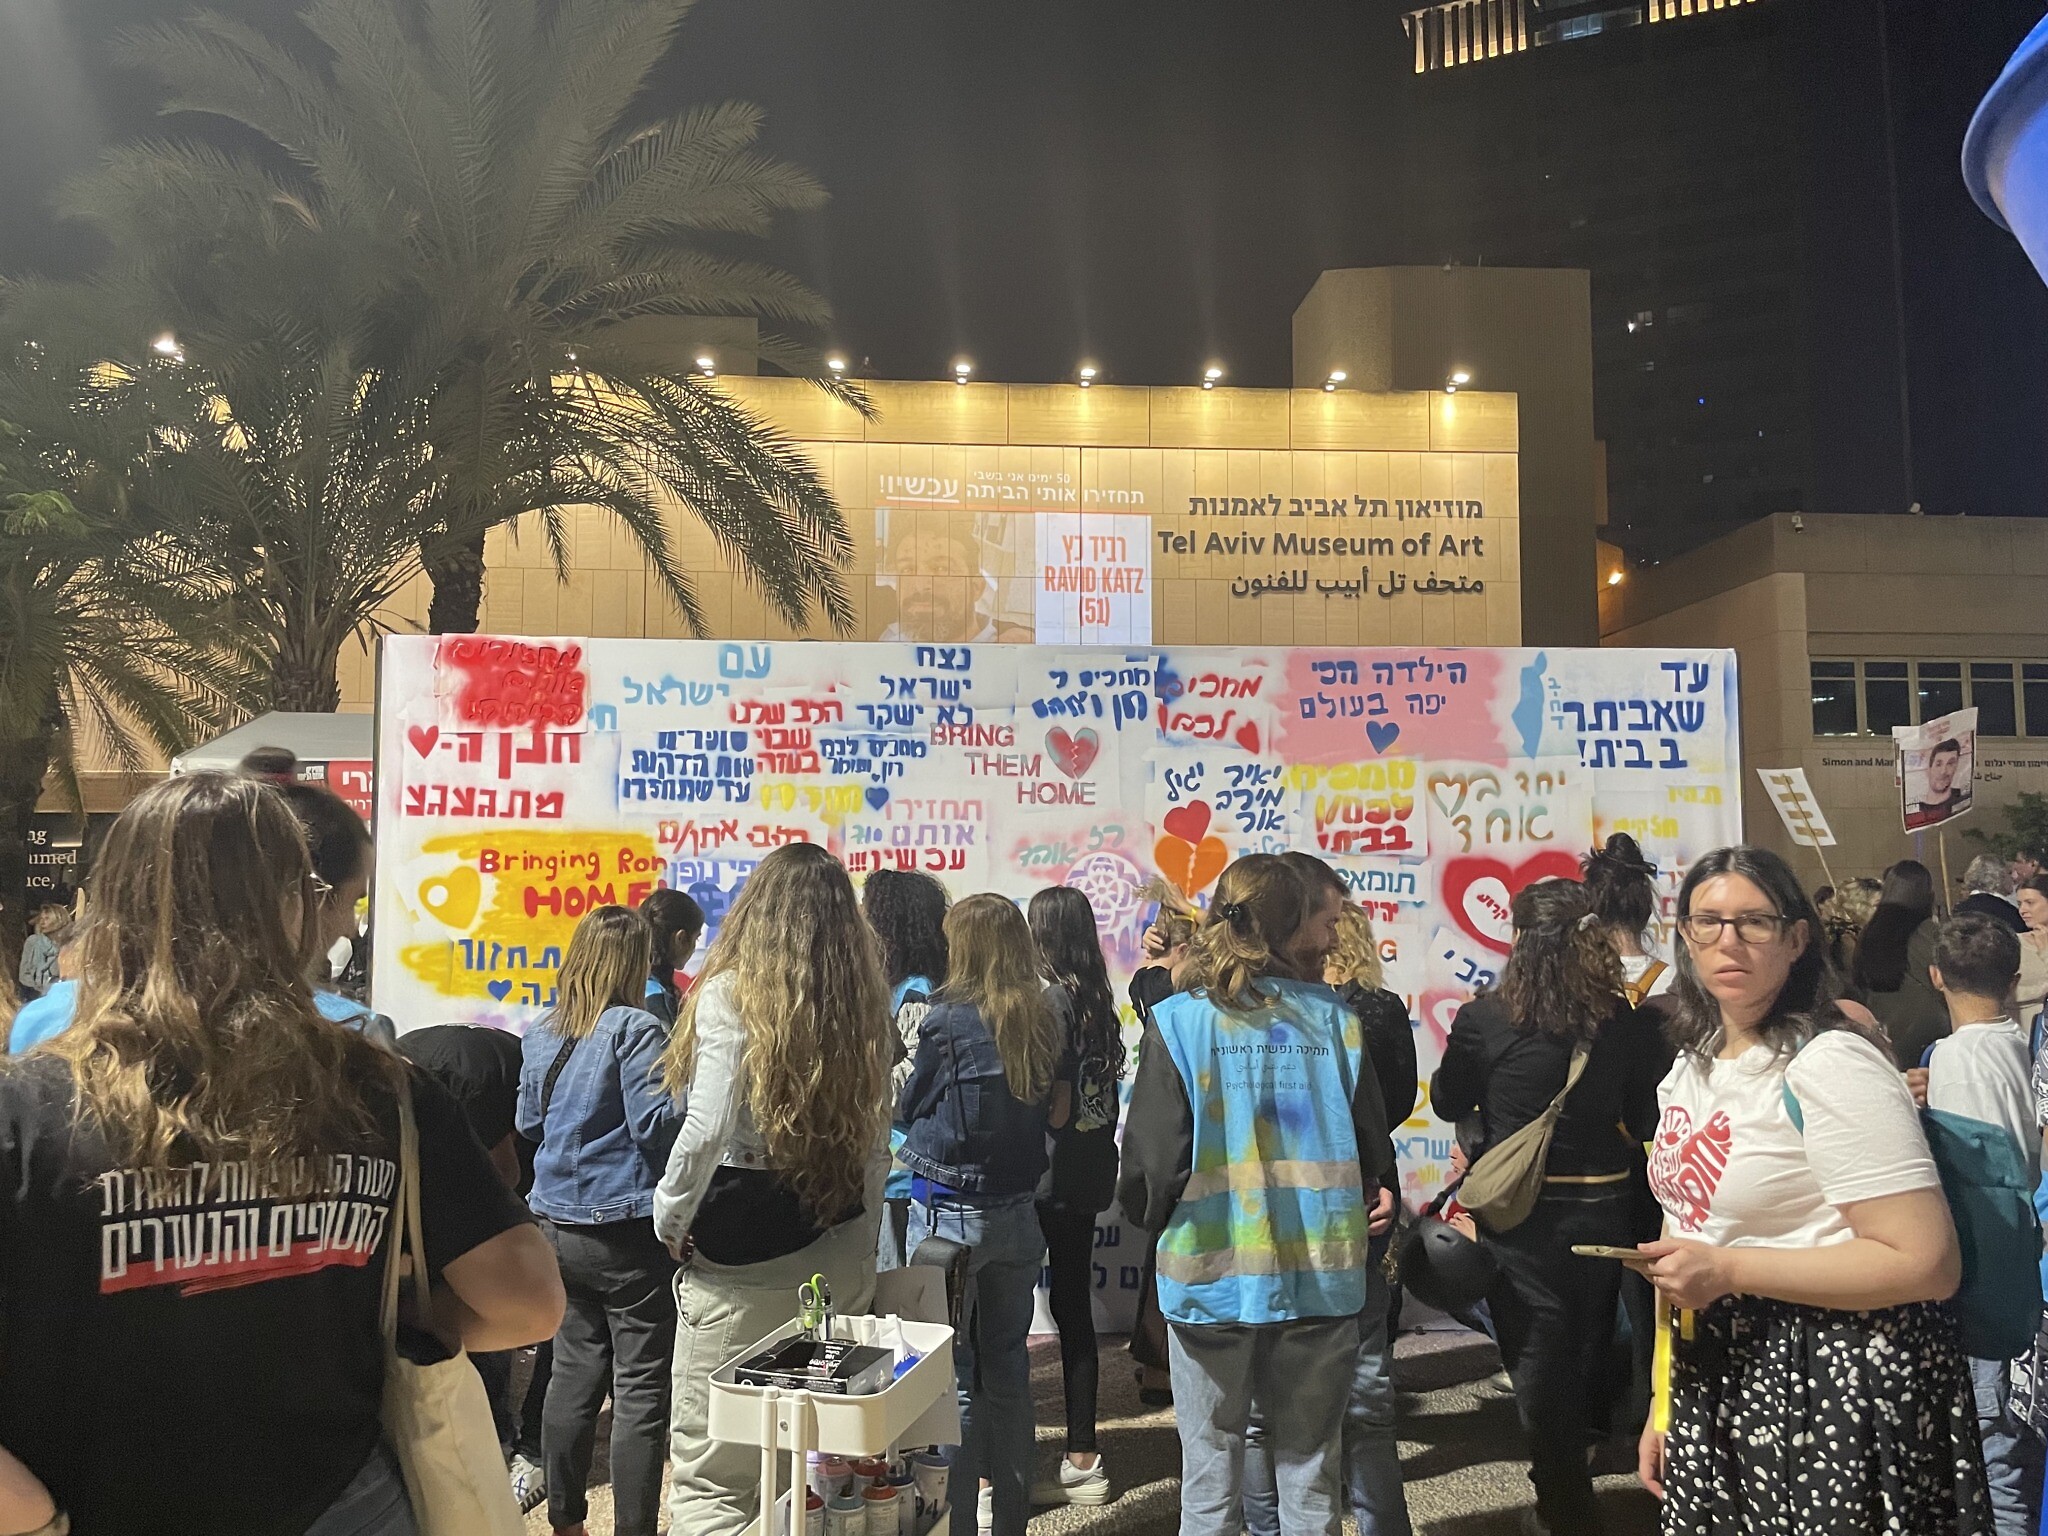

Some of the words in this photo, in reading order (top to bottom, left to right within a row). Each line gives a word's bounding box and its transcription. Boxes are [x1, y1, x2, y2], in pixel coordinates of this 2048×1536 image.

[880, 474, 958, 498] עכשיו!
[973, 471, 1002, 481] בשבי
[1007, 472, 1024, 482] אני
[1057, 474, 1070, 484] 50
[966, 483, 1028, 500] הביתה
[1036, 485, 1077, 502] אותי
[1084, 486, 1144, 504] תחזירו
[1189, 494, 1282, 517] לאמנות
[1288, 497, 1348, 517] אביב
[1354, 494, 1388, 518] תל
[1398, 498, 1483, 521] מוזיאון
[1062, 535, 1083, 565] כץ
[1089, 536, 1126, 562] רביד
[1158, 530, 1195, 554] Tel
[1204, 531, 1266, 555] Aviv
[1274, 532, 1394, 556] Museum
[1401, 532, 1431, 556] of
[1439, 534, 1484, 557] Art
[1044, 566, 1096, 593] RAVID
[1102, 567, 1144, 594] KATZ
[1230, 569, 1308, 598] للفنون
[1315, 565, 1369, 598] أبيب
[1377, 570, 1406, 598] تل
[1413, 570, 1484, 596] متحف
[1078, 596, 1110, 627] (51)
[718, 643, 771, 679] עם
[916, 646, 972, 671] נצח
[1371, 655, 1467, 685] הילדה
[1311, 660, 1358, 685] הכי
[1660, 662, 1709, 694] עד
[623, 675, 730, 706] ישראל
[880, 675, 972, 701] ישראל
[790, 698, 844, 725] הלב
[856, 704, 924, 730] ישקר
[938, 704, 974, 728] לא
[1300, 692, 1388, 720] בעולם
[1405, 693, 1447, 716] יפה
[1562, 700, 1706, 733] שאביתר
[754, 728, 812, 750] שבוי
[930, 723, 1014, 747] BRING
[756, 750, 821, 774] בעזה
[964, 752, 1042, 778] THEM
[1822, 758, 1853, 766] Simon
[1854, 757, 1873, 766] and
[1875, 758, 1894, 766] Mar
[1018, 782, 1096, 806] HOME
[885, 798, 982, 822] תחזירו
[892, 824, 975, 847] אותם
[480, 848, 600, 882] Bringing
[102, 1207, 260, 1280] והנעדרים
